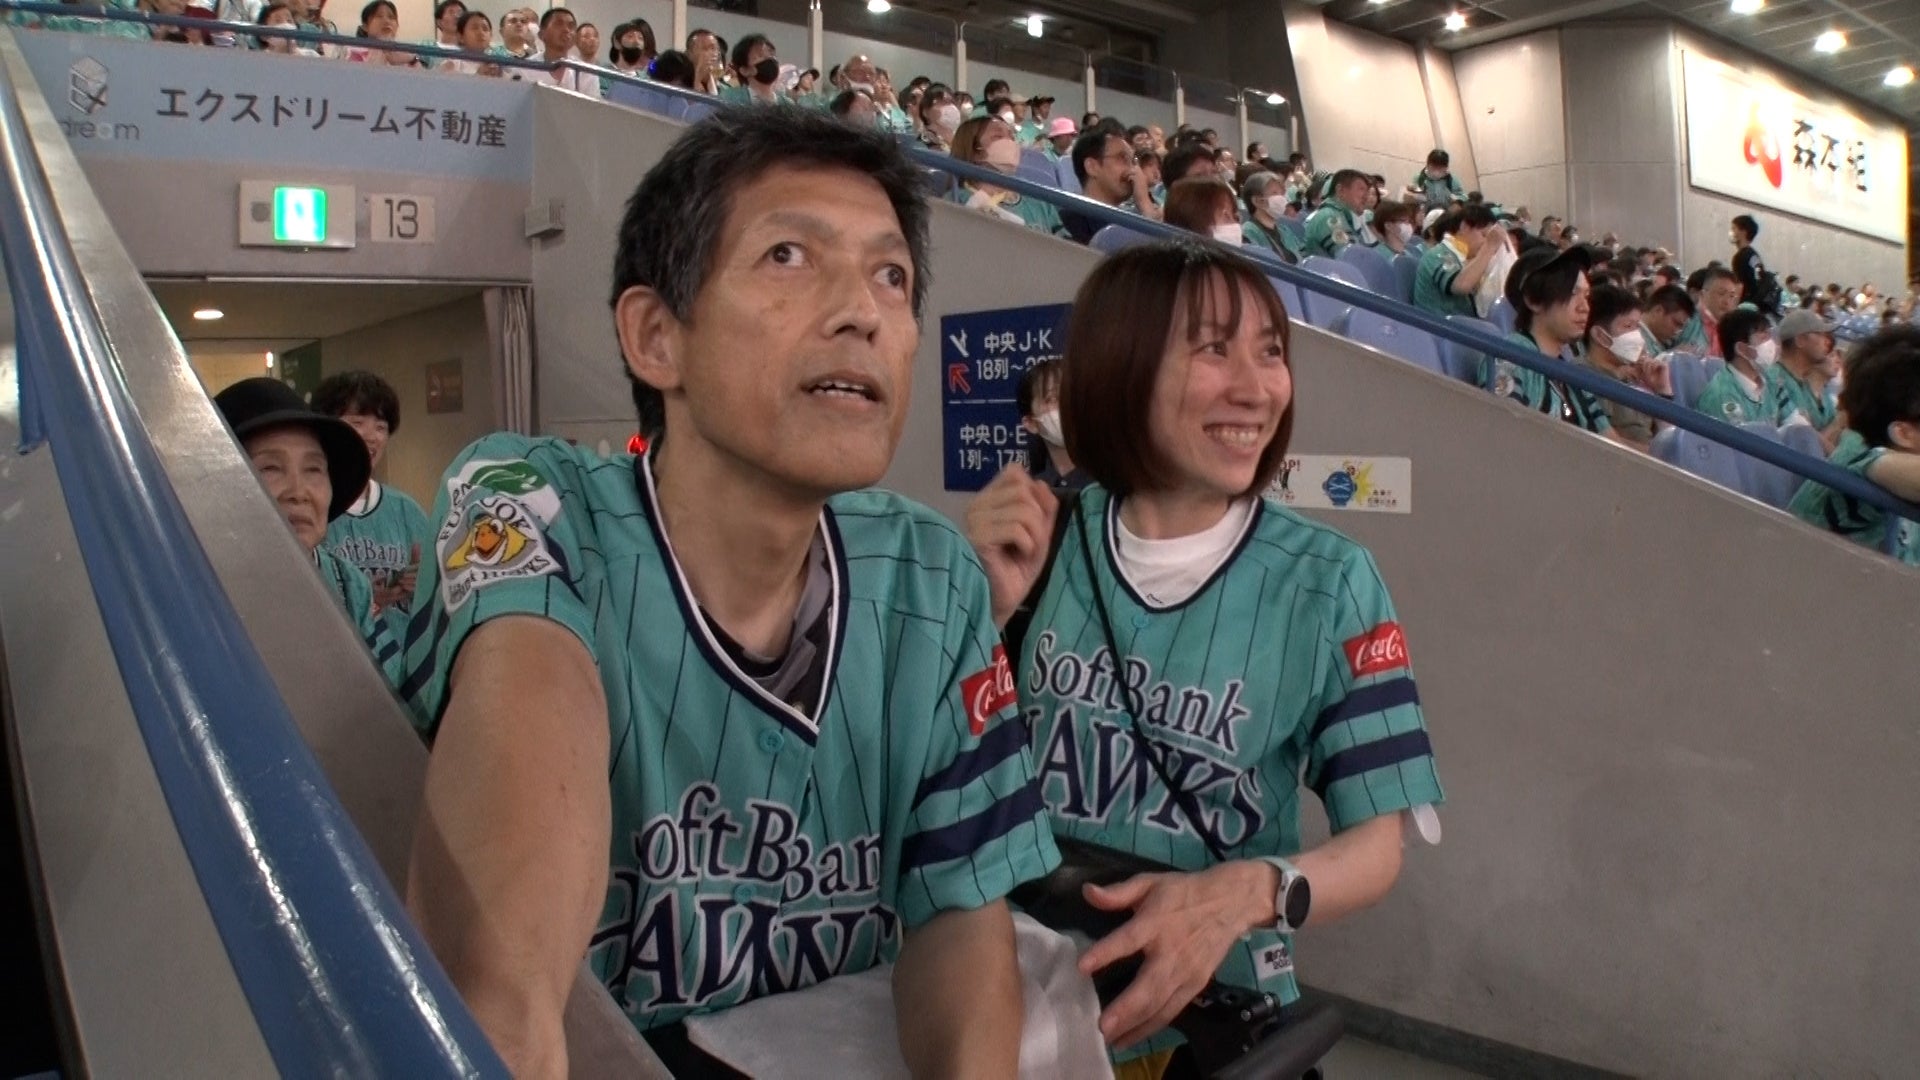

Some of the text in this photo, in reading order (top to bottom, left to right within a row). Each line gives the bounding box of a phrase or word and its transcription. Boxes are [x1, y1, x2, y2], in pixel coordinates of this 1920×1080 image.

[156, 87, 508, 148] エクスドリーム不動産
[384, 197, 419, 239] 13
